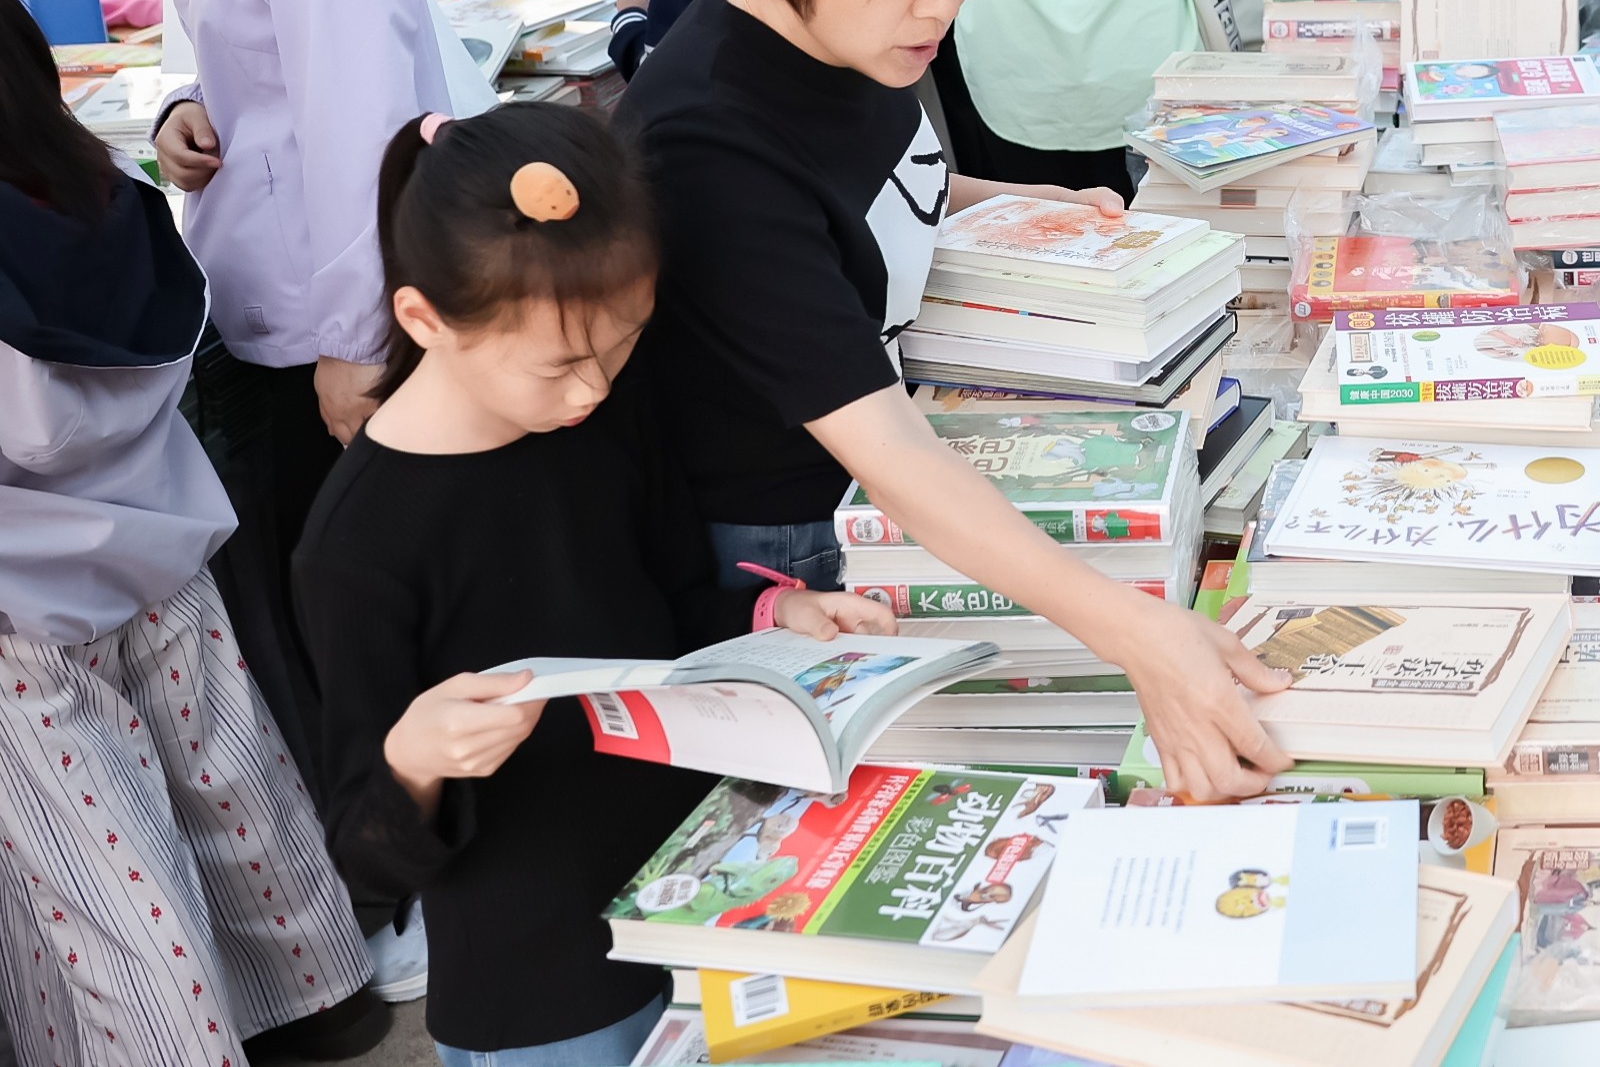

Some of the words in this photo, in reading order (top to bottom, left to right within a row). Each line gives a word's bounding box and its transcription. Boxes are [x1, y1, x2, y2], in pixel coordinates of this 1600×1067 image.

[1349, 387, 1415, 401] 健康中国2030
[917, 587, 1015, 613] 大象巴巴
[878, 789, 1004, 922] 动物百科
